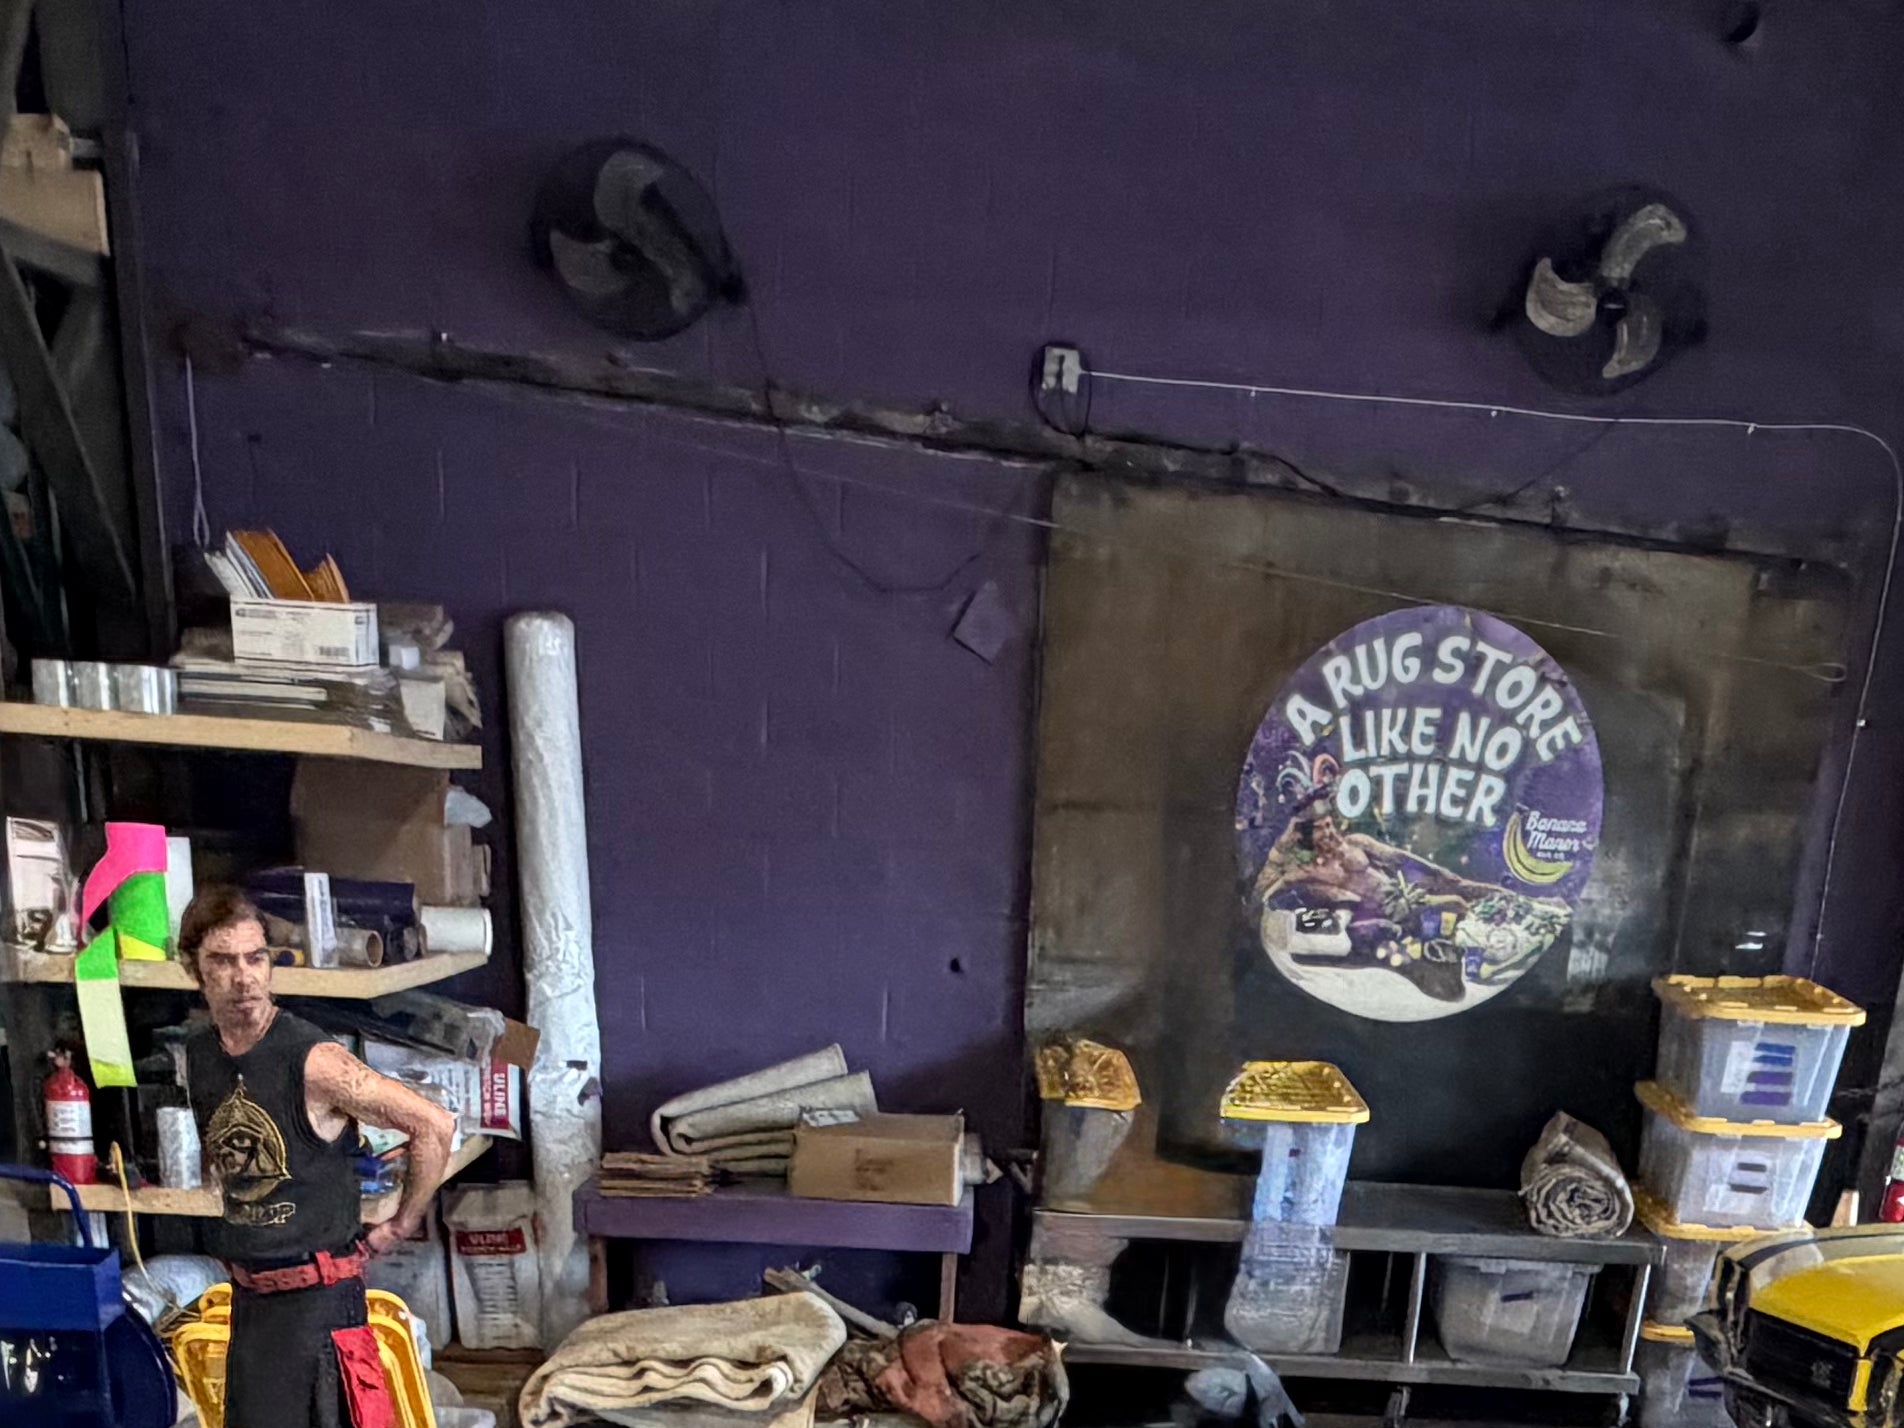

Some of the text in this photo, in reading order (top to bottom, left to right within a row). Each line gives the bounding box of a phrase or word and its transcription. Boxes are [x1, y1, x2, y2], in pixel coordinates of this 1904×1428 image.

[1286, 631, 1583, 761] A RUG STORE
[1339, 707, 1523, 770] LIKE NO
[1336, 762, 1506, 827] OTHER
